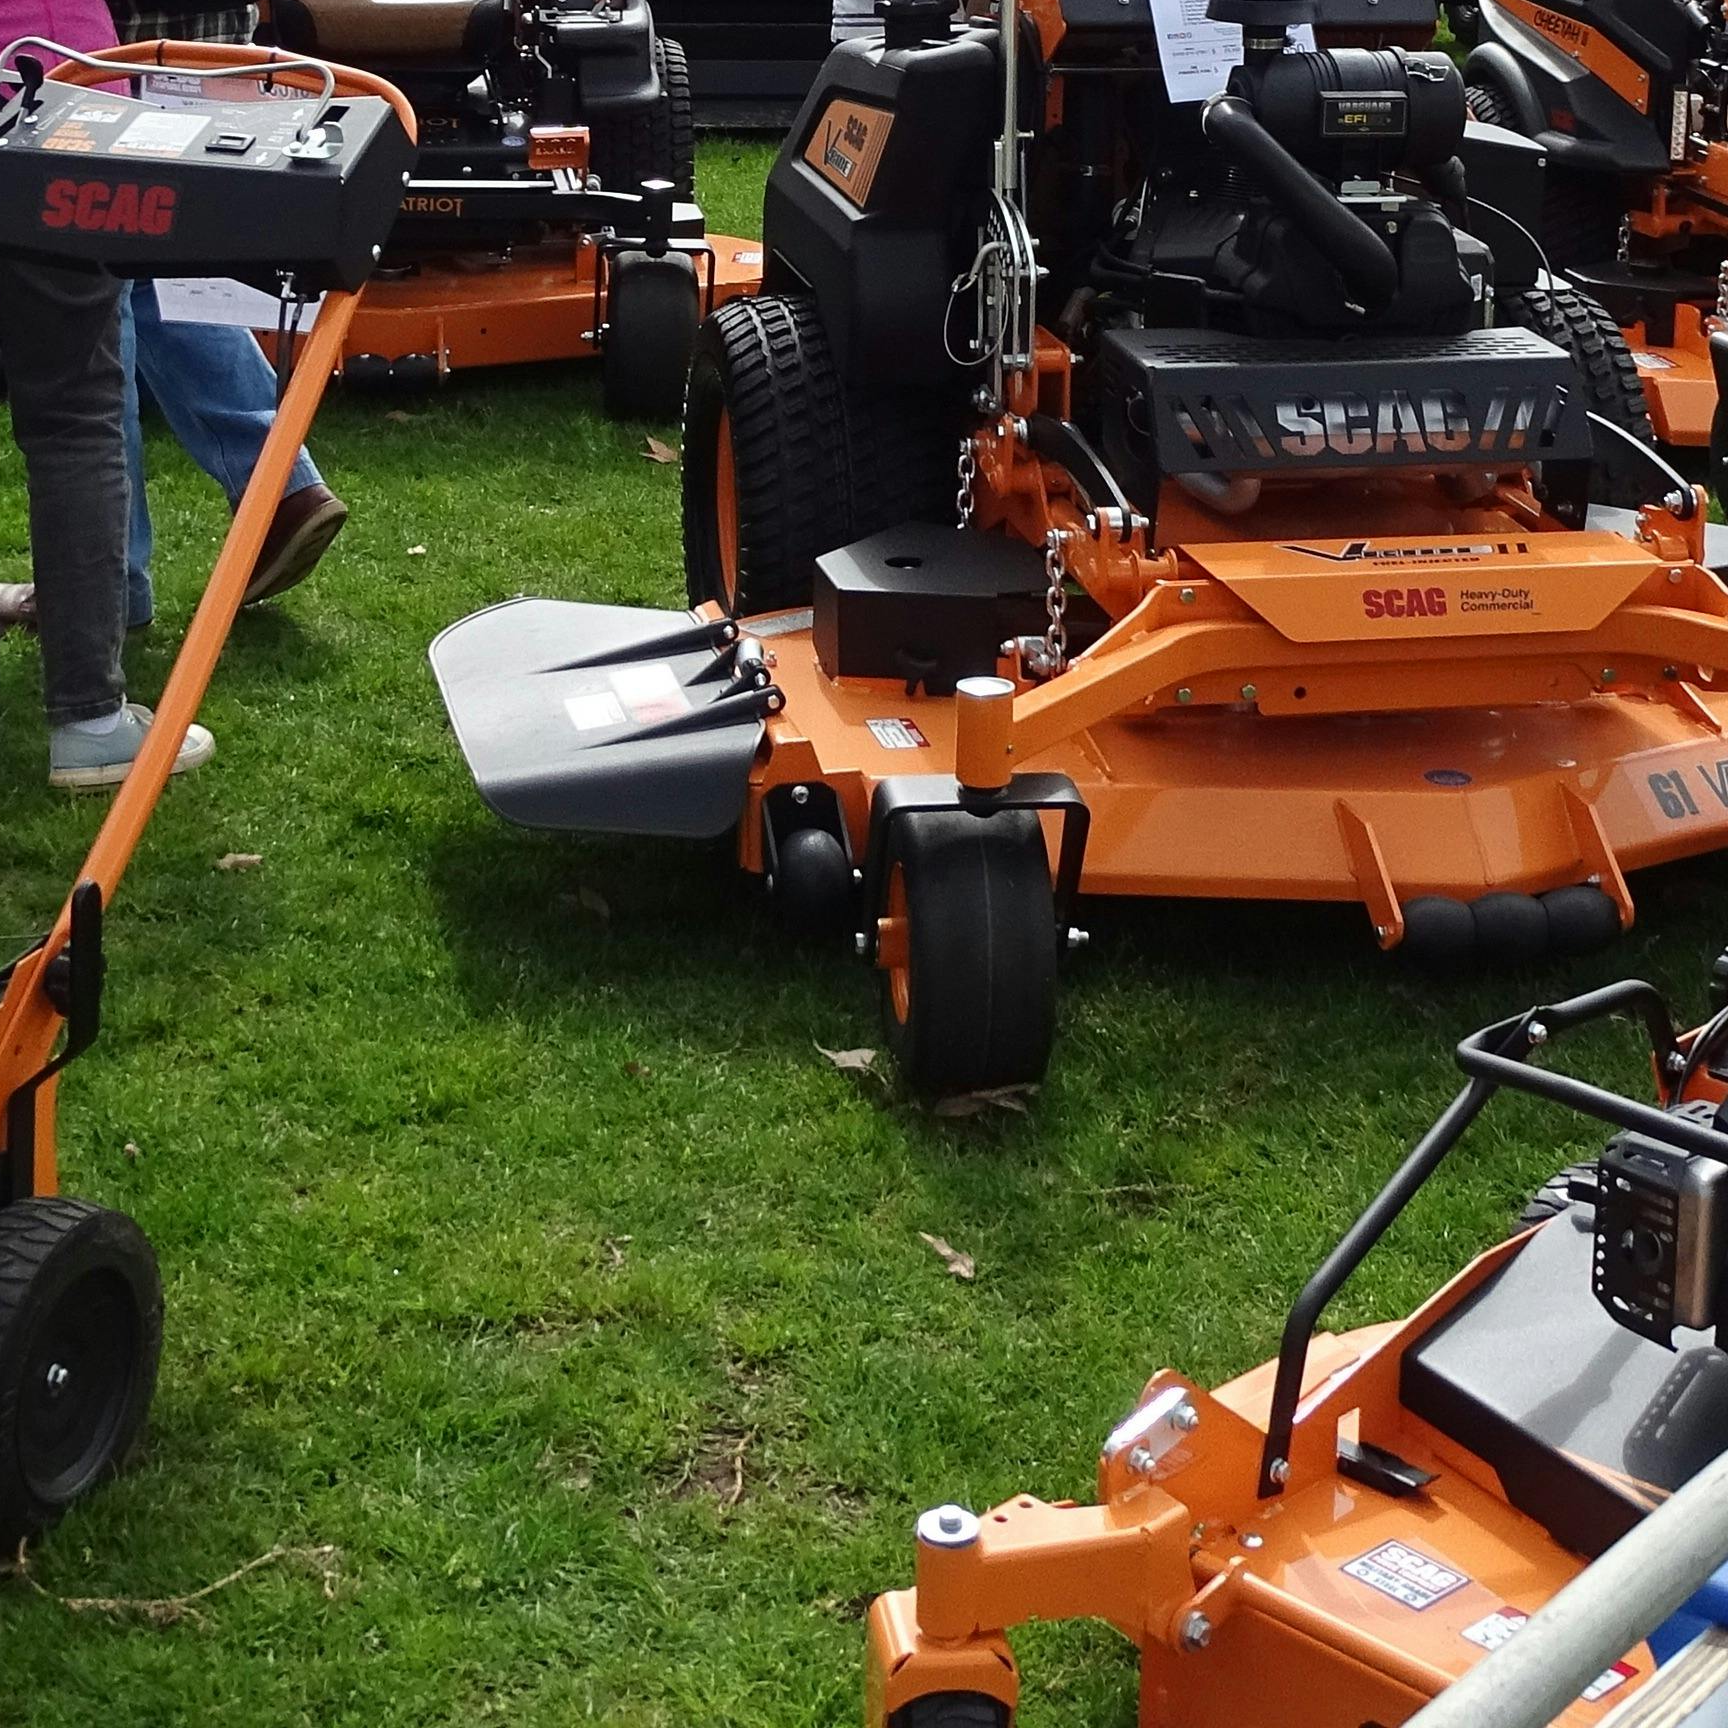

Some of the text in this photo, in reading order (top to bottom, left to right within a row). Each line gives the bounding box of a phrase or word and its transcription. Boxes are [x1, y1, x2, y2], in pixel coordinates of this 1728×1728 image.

[1533, 9, 1581, 44] CHEETAH
[1344, 114, 1368, 124] EFI
[41, 178, 177, 235] SCAG
[1275, 389, 1472, 457] SCAG
[1362, 586, 1448, 620] SCAG
[1459, 588, 1531, 603] Heavy-Duty
[1459, 599, 1535, 614] Commercial
[1647, 768, 1702, 820] 61
[1378, 1546, 1460, 1590] SCAG
